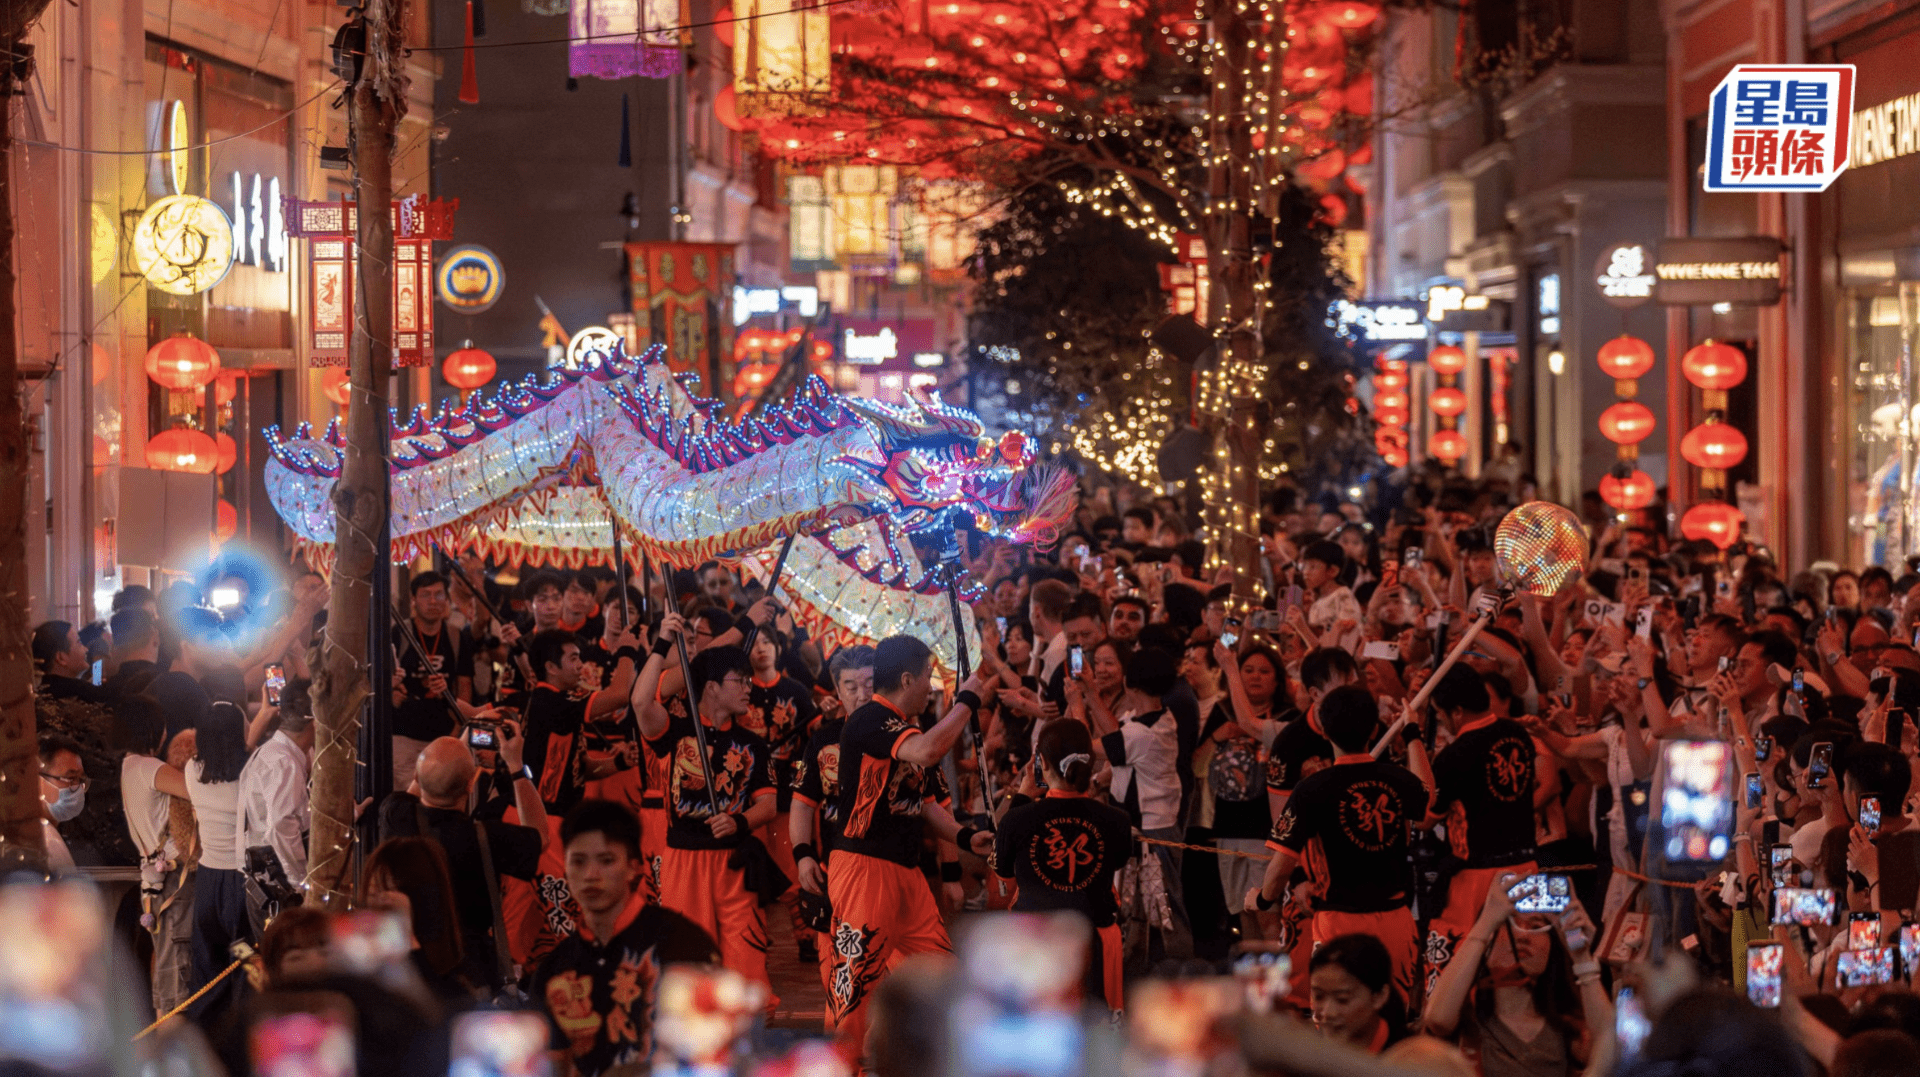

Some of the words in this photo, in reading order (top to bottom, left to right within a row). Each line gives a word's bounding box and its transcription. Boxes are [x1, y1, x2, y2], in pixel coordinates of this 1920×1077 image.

[1656, 263, 1741, 279] VIVIENNE
[1741, 262, 1780, 278] TAM
[1045, 818, 1081, 828] KWOK'S
[1082, 820, 1102, 839] KUNG
[1351, 792, 1396, 843] 郭
[1044, 828, 1094, 884] 郭
